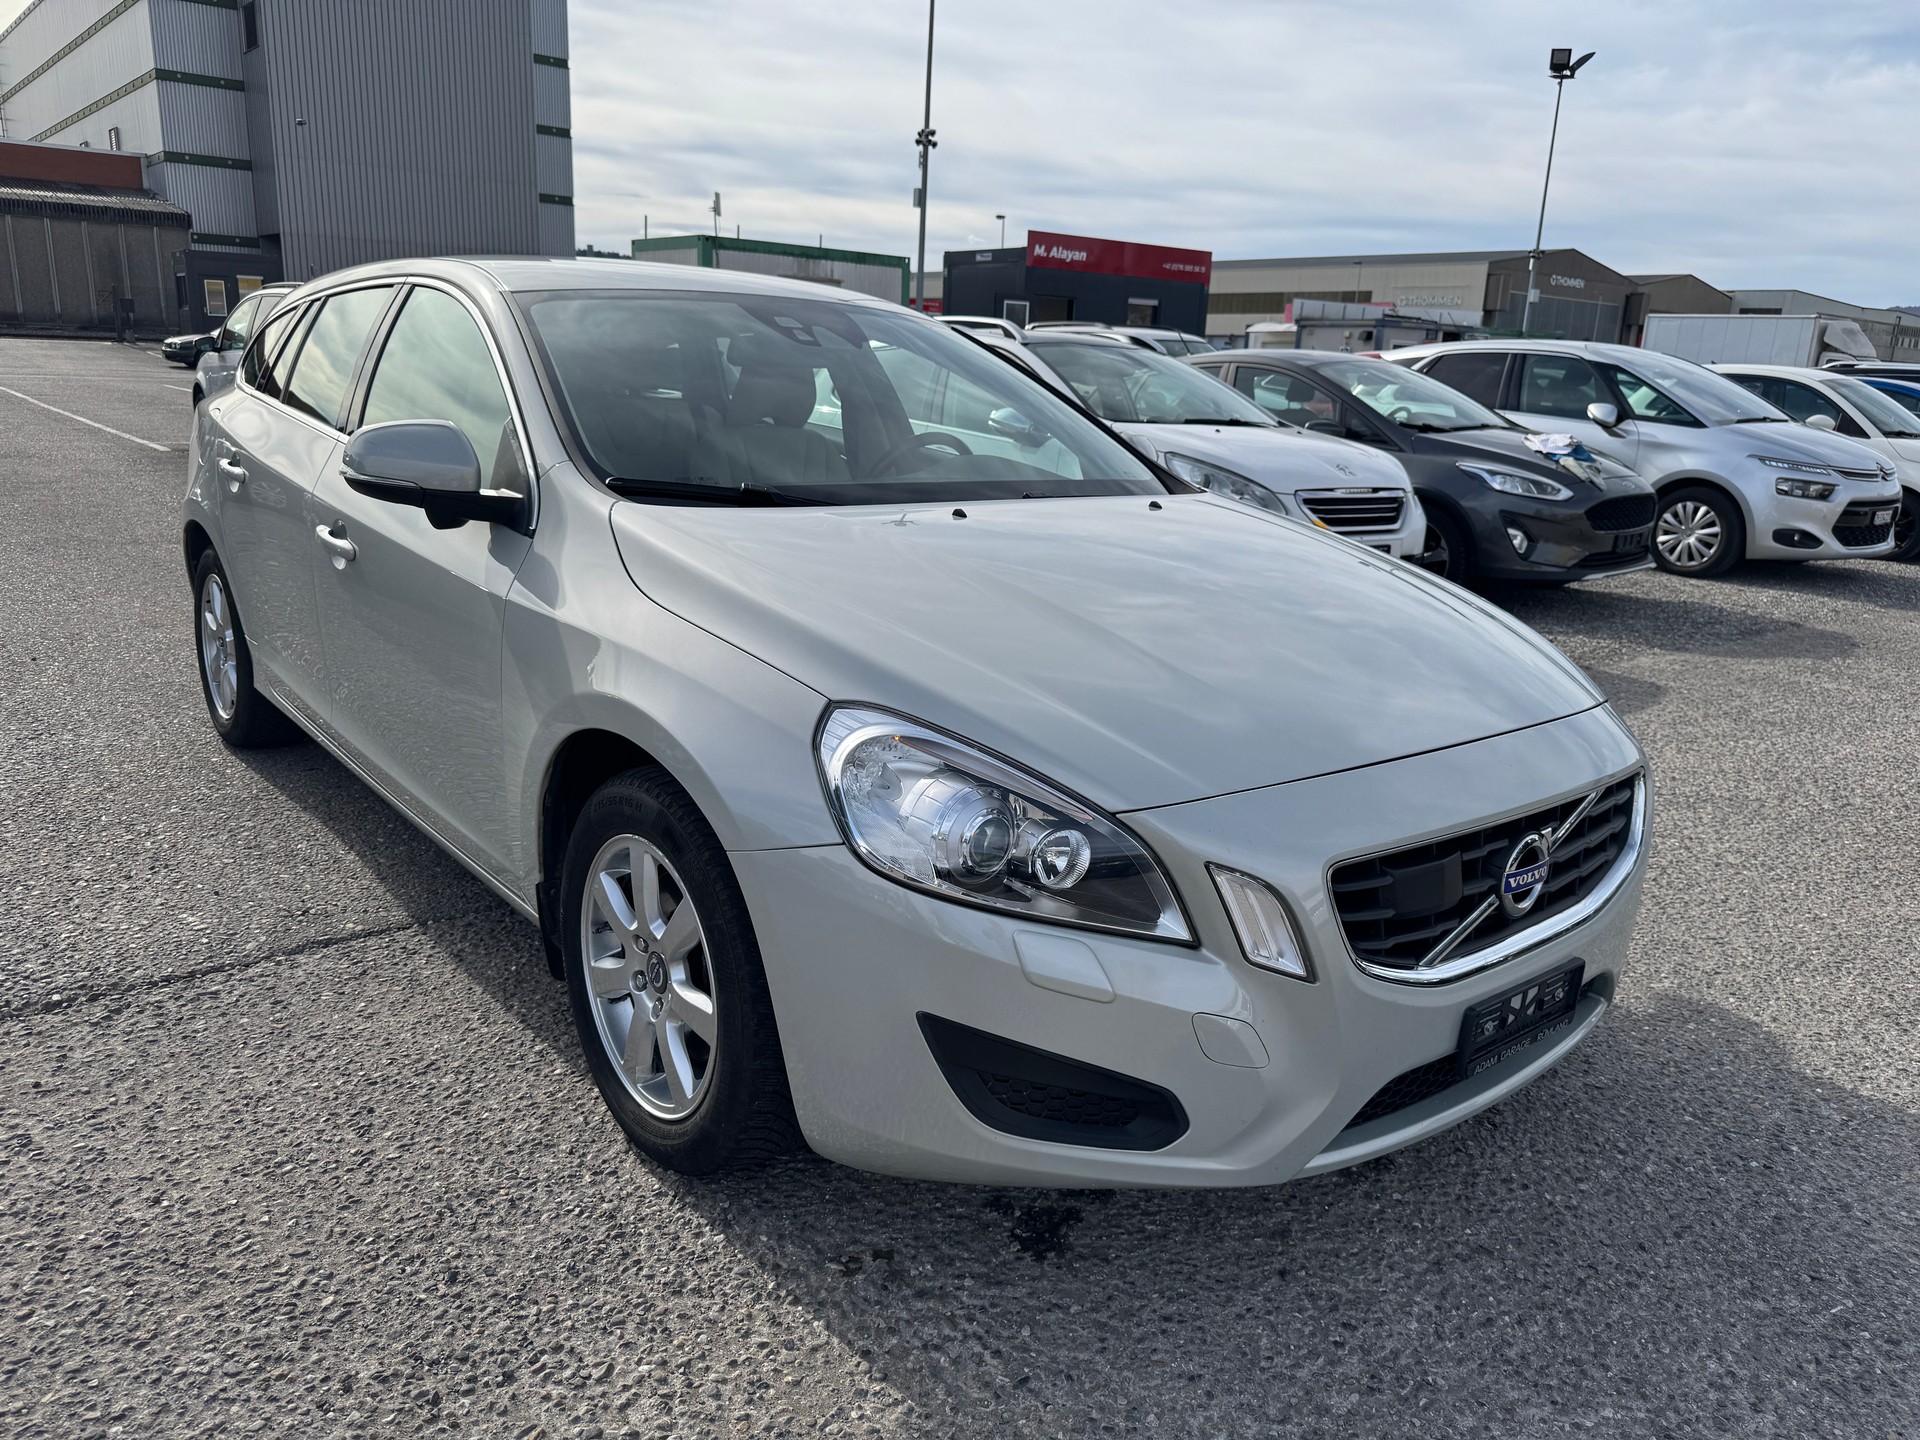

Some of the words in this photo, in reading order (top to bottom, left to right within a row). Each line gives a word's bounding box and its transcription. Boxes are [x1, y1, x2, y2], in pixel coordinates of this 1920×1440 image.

[1034, 244, 1047, 257] M.
[1049, 246, 1087, 262] Alayan
[1557, 275, 1585, 288] THOMMEN
[1408, 295, 1462, 306] THOMMEN
[1508, 866, 1548, 888] VOLVO
[1474, 1055, 1498, 1076] ADAM
[1500, 1038, 1531, 1060] GARAGE
